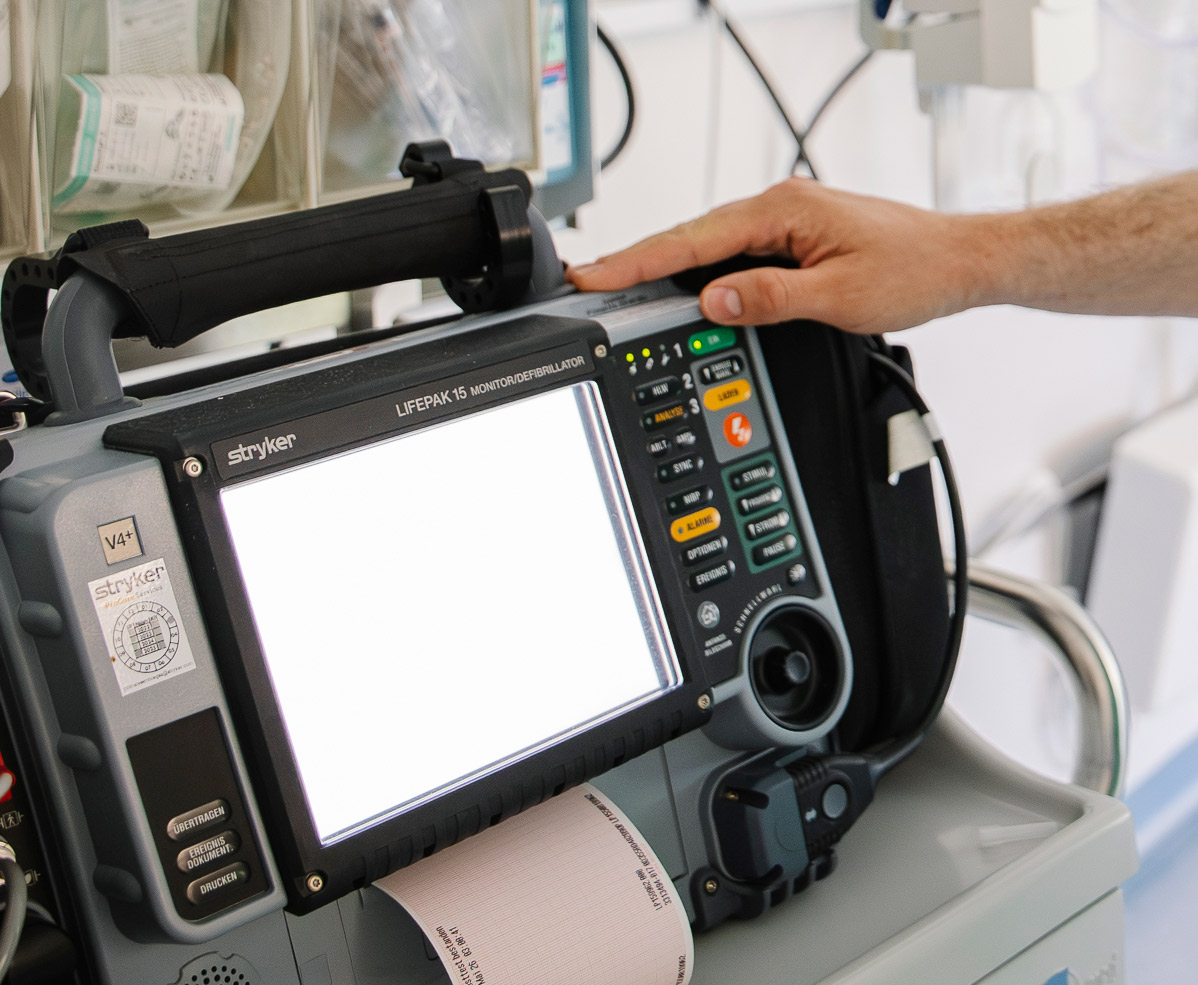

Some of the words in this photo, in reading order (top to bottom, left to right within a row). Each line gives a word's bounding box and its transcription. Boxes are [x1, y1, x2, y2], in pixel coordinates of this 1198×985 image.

[673, 343, 684, 358] 1
[395, 390, 452, 418] LIFEPAK
[452, 385, 468, 403] 15
[469, 355, 585, 397] MONITOR/DEFIBRILLATOR
[682, 373, 694, 390] 2
[654, 405, 684, 423] ANALYSE
[689, 398, 700, 414] 3
[227, 432, 297, 466] stryker
[673, 459, 694, 474] SYNC
[683, 491, 700, 505] NIBP
[105, 530, 134, 550] V4+
[687, 540, 722, 560] OPTIONEN
[763, 541, 786, 557] PAUSE
[94, 566, 165, 602] stryker
[695, 565, 728, 585] EREIGNIS
[173, 806, 225, 835] ÜBERTRAGEN
[189, 836, 226, 859] EREIGNIS
[200, 871, 238, 895] DRUCKEN
[436, 925, 460, 960] bestanden
[468, 960, 479, 971] 26
